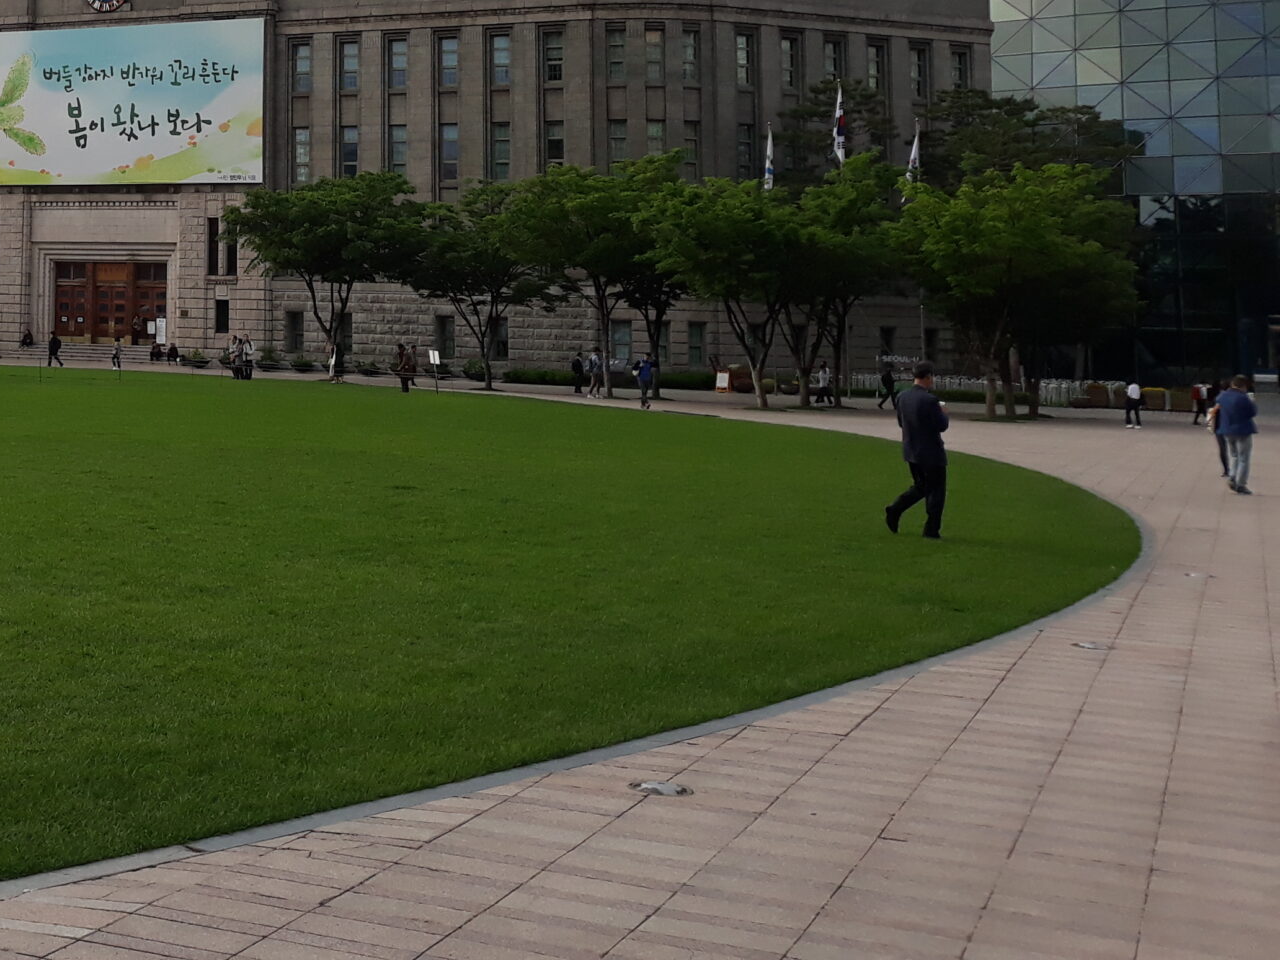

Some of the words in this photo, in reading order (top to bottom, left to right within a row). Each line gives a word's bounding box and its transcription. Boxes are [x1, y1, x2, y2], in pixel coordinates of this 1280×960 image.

[42, 63, 114, 92] 버들강아지
[120, 62, 164, 86] 반가워
[167, 59, 195, 86] 꼬리
[198, 58, 239, 85] 흔든다
[67, 97, 105, 149] 봄이
[111, 103, 160, 142] 왔나
[167, 108, 212, 136] 보다
